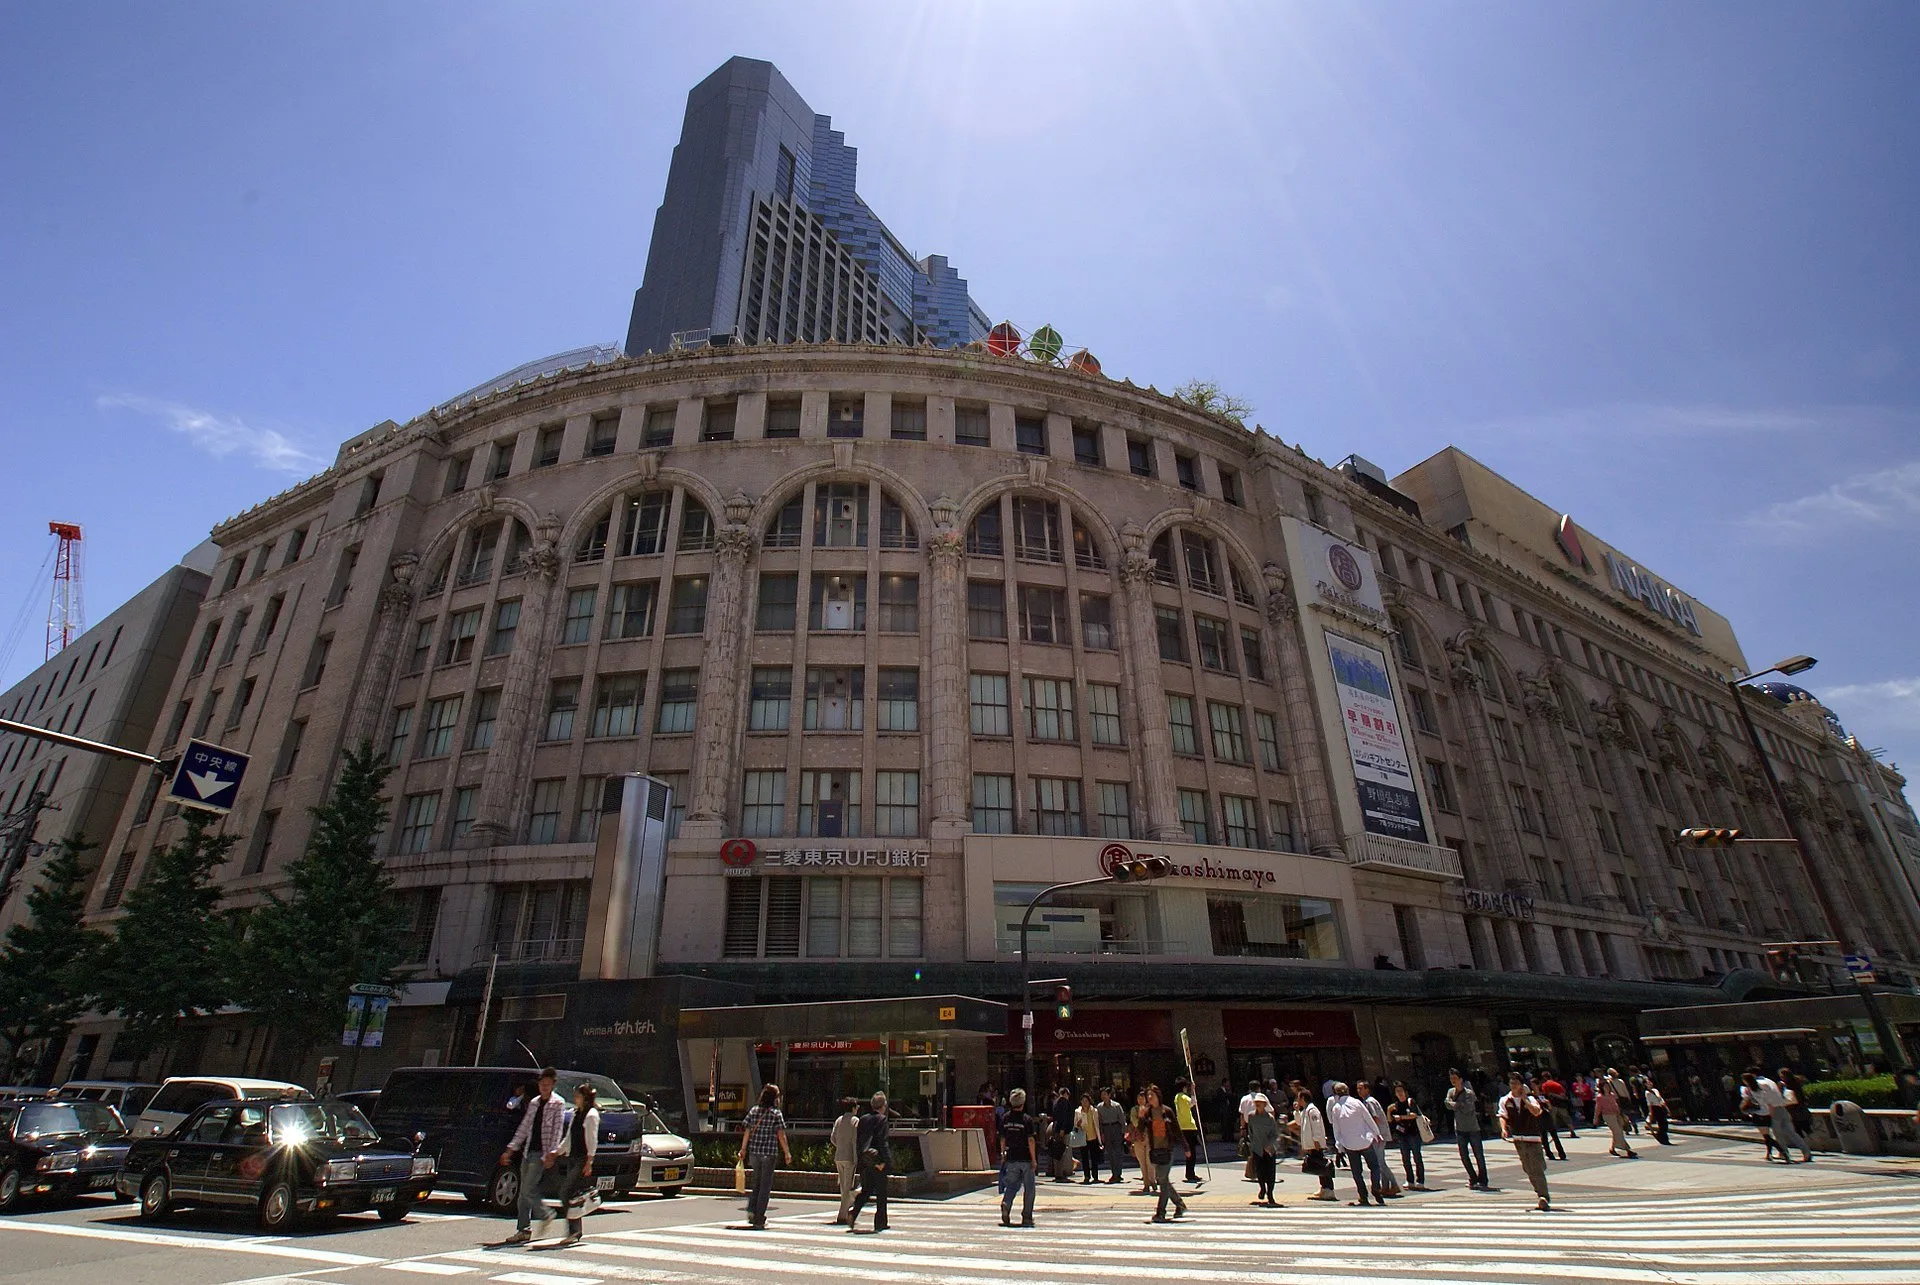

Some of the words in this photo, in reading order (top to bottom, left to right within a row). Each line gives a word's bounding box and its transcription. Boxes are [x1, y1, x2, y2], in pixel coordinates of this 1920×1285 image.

[1605, 552, 1702, 637] NANKAI
[195, 751, 238, 773] 中央線
[763, 849, 931, 868] 三菱東京UFJ銀行
[943, 1009, 952, 1018] E4
[583, 1027, 613, 1036] NAMBA
[613, 1020, 656, 1035] なんなん
[1065, 1031, 1110, 1040] Takashimaya
